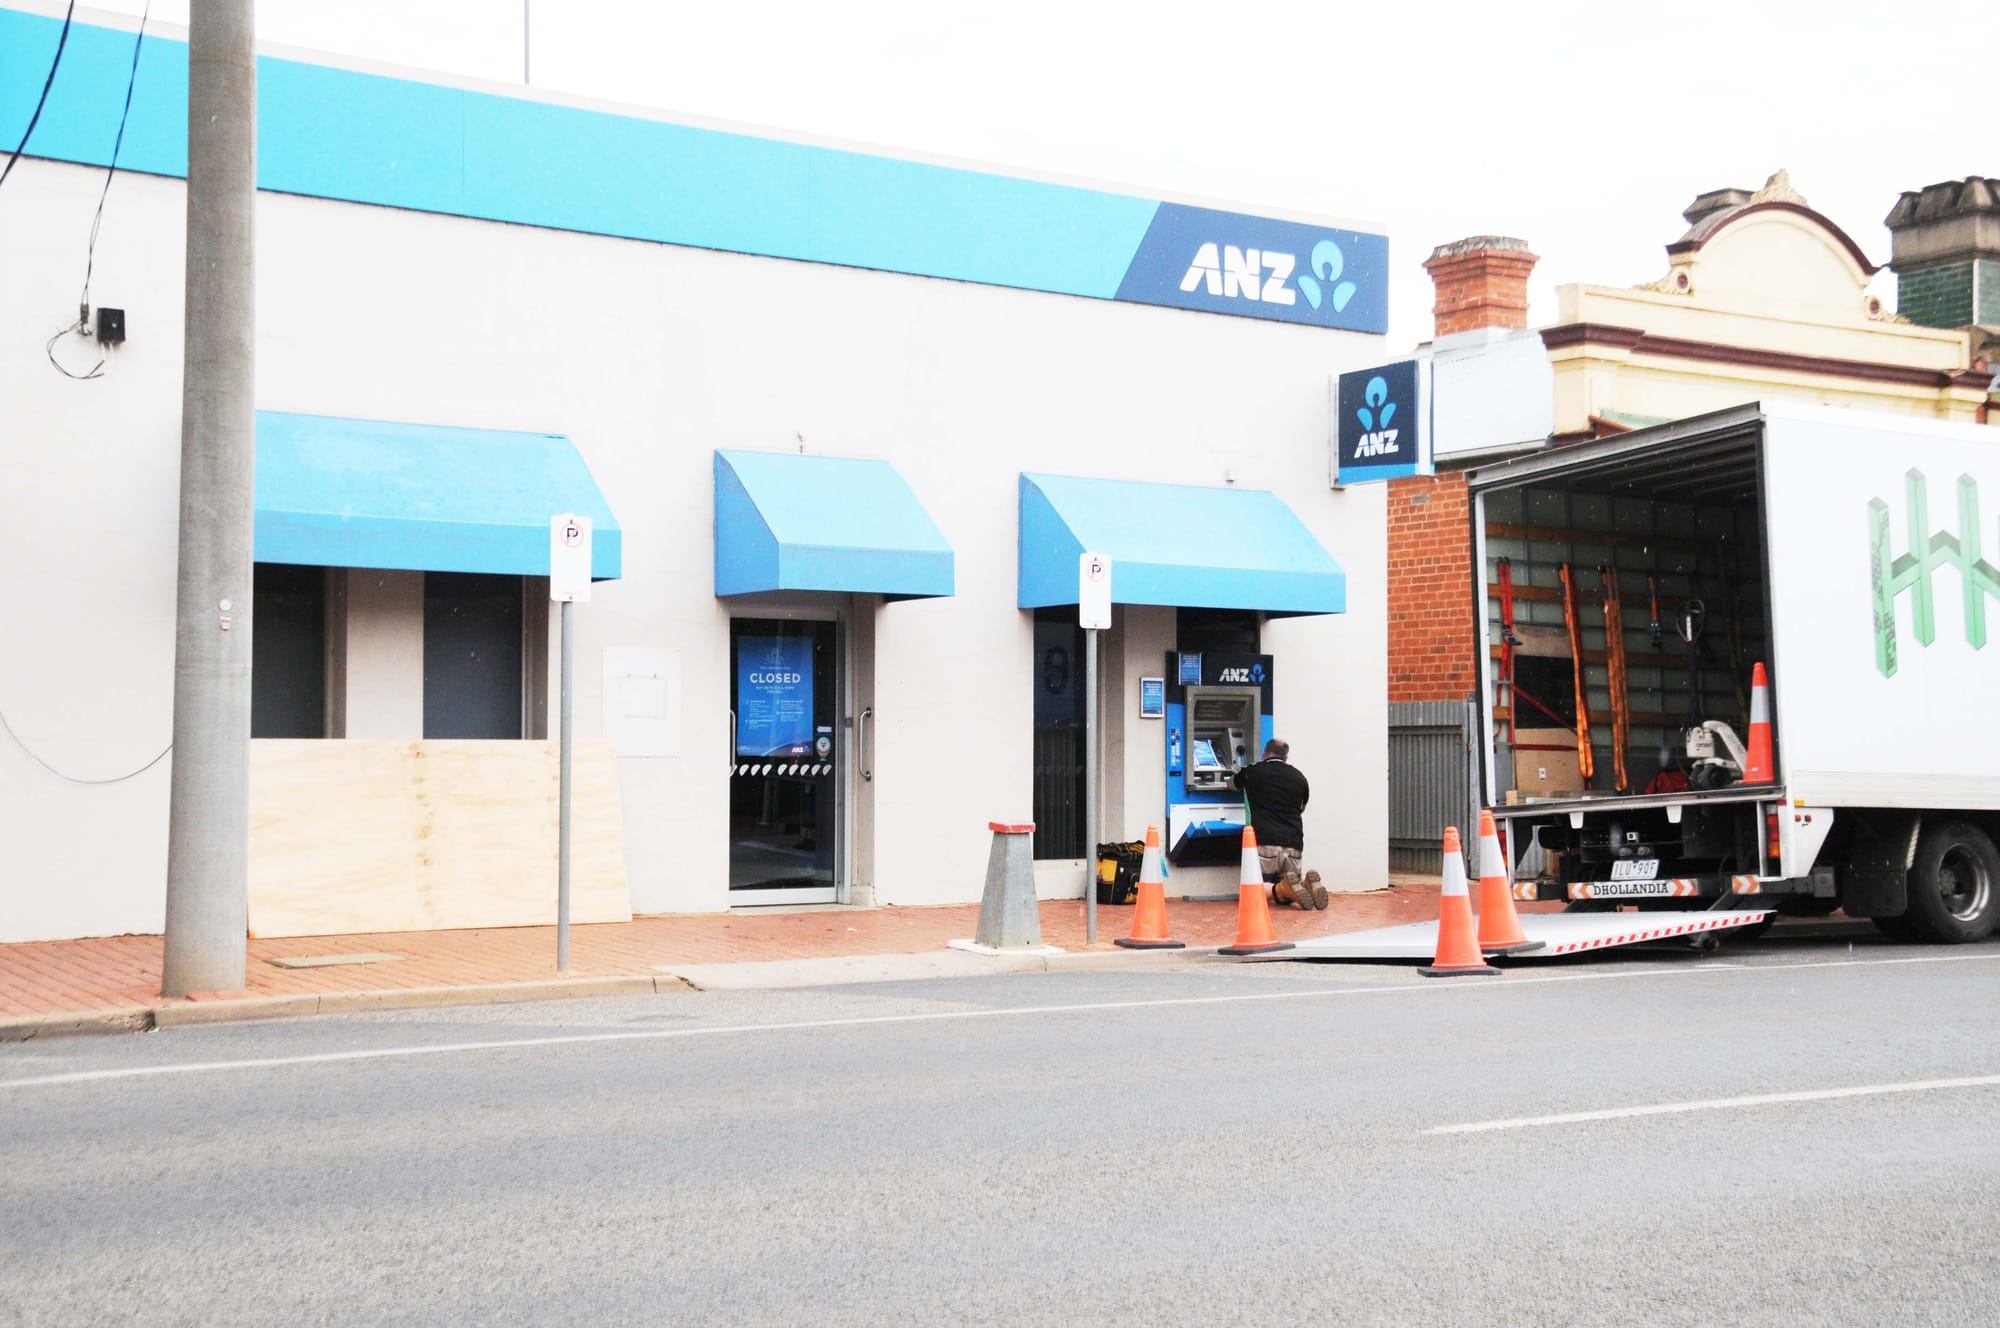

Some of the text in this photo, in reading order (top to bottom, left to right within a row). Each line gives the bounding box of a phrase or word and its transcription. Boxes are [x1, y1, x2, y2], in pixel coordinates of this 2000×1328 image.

[1180, 242, 1296, 306] ANZ
[1354, 428, 1399, 458] ANZ
[750, 673, 801, 683] CLOSED
[1219, 668, 1250, 682] ANZ
[1593, 881, 1669, 897] DHOLLANDIA
